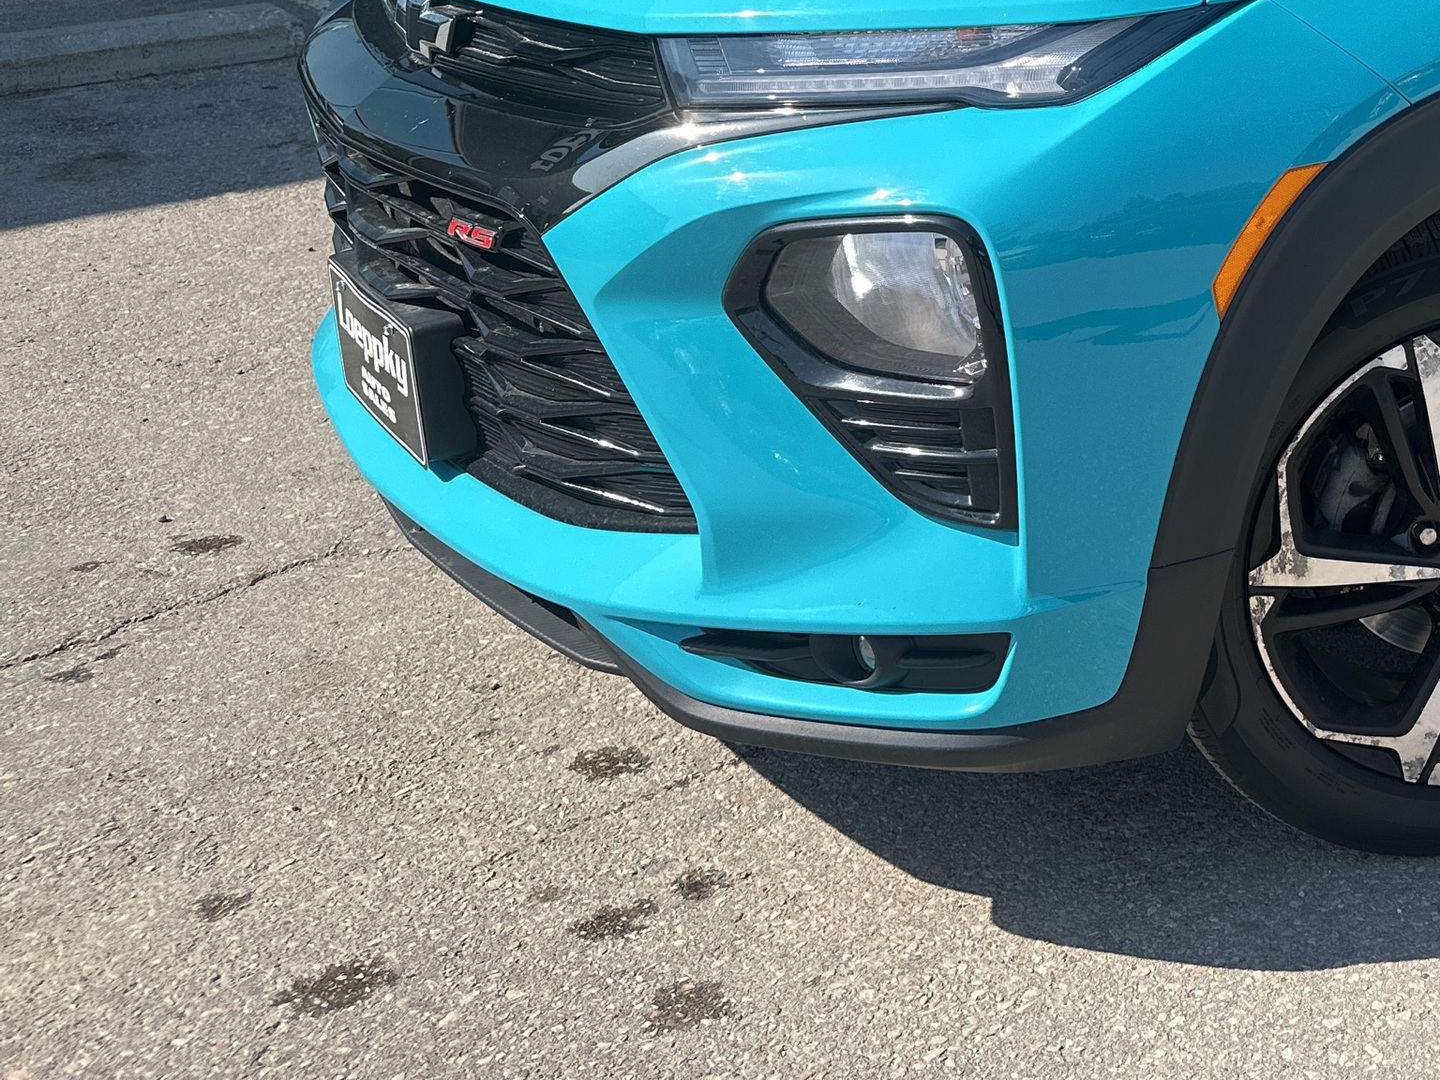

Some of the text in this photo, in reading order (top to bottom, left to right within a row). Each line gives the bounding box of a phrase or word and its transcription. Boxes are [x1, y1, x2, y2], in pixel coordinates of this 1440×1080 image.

[447, 217, 497, 249] RS
[1353, 269, 1426, 318] P7
[336, 291, 409, 398] Loeppky
[361, 365, 392, 404] AUTO
[361, 379, 397, 424] SALES
